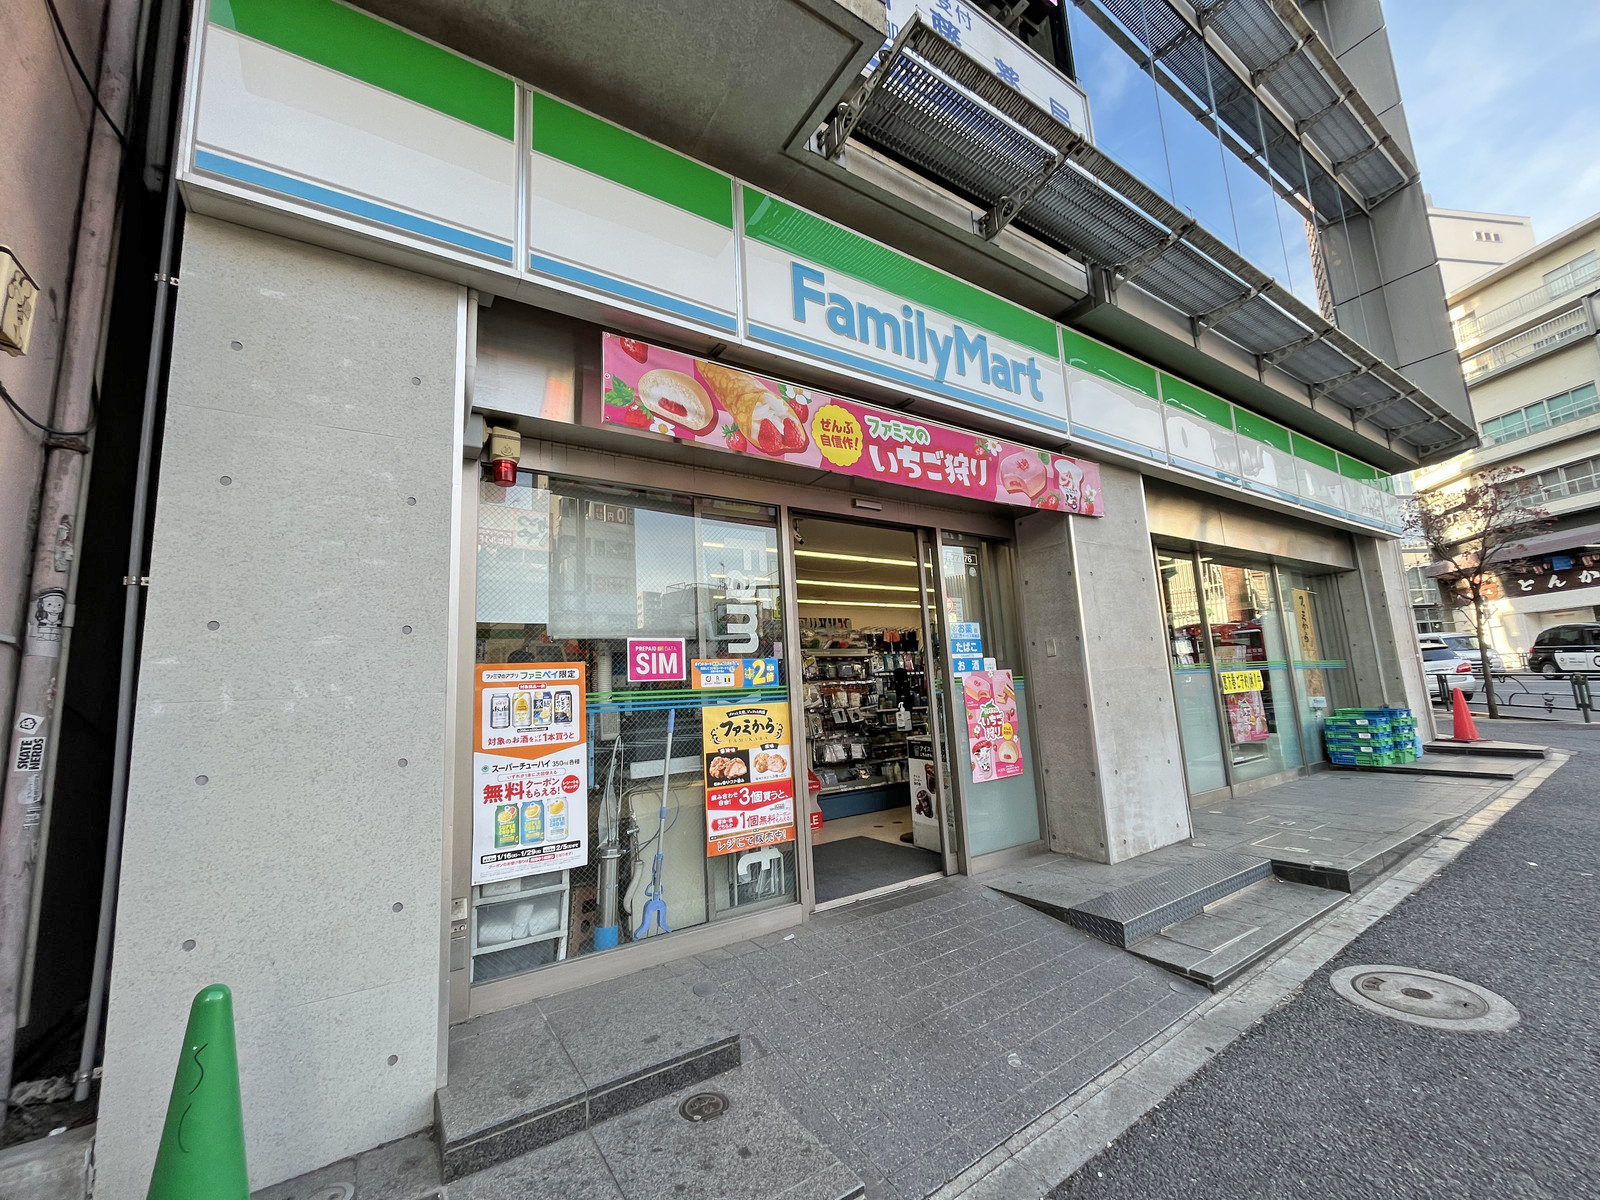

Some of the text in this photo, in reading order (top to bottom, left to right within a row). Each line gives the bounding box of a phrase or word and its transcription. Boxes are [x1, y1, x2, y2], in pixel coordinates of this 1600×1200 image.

[790, 260, 1044, 402] FamilyMart
[820, 418, 854, 434] ぜんぶ
[866, 415, 930, 444] ファミマの
[820, 435, 859, 451] 自信作!
[868, 445, 988, 487] いちご狩り
[956, 642, 978, 652] たばこ
[635, 652, 678, 675] SIM
[520, 669, 576, 680] ファミペイ限定
[720, 717, 775, 737] ファミから
[487, 735, 534, 746] 対象のお酒を
[542, 732, 575, 742] 1本買うと
[17, 740, 33, 770] SKATE
[28, 738, 44, 770] NERDS
[492, 760, 551, 773] スーパーチューハイ
[482, 780, 525, 804] 無料
[525, 779, 560, 789] クーポン
[525, 787, 560, 799] もらえる!
[717, 829, 787, 851] レジにて販売中!
